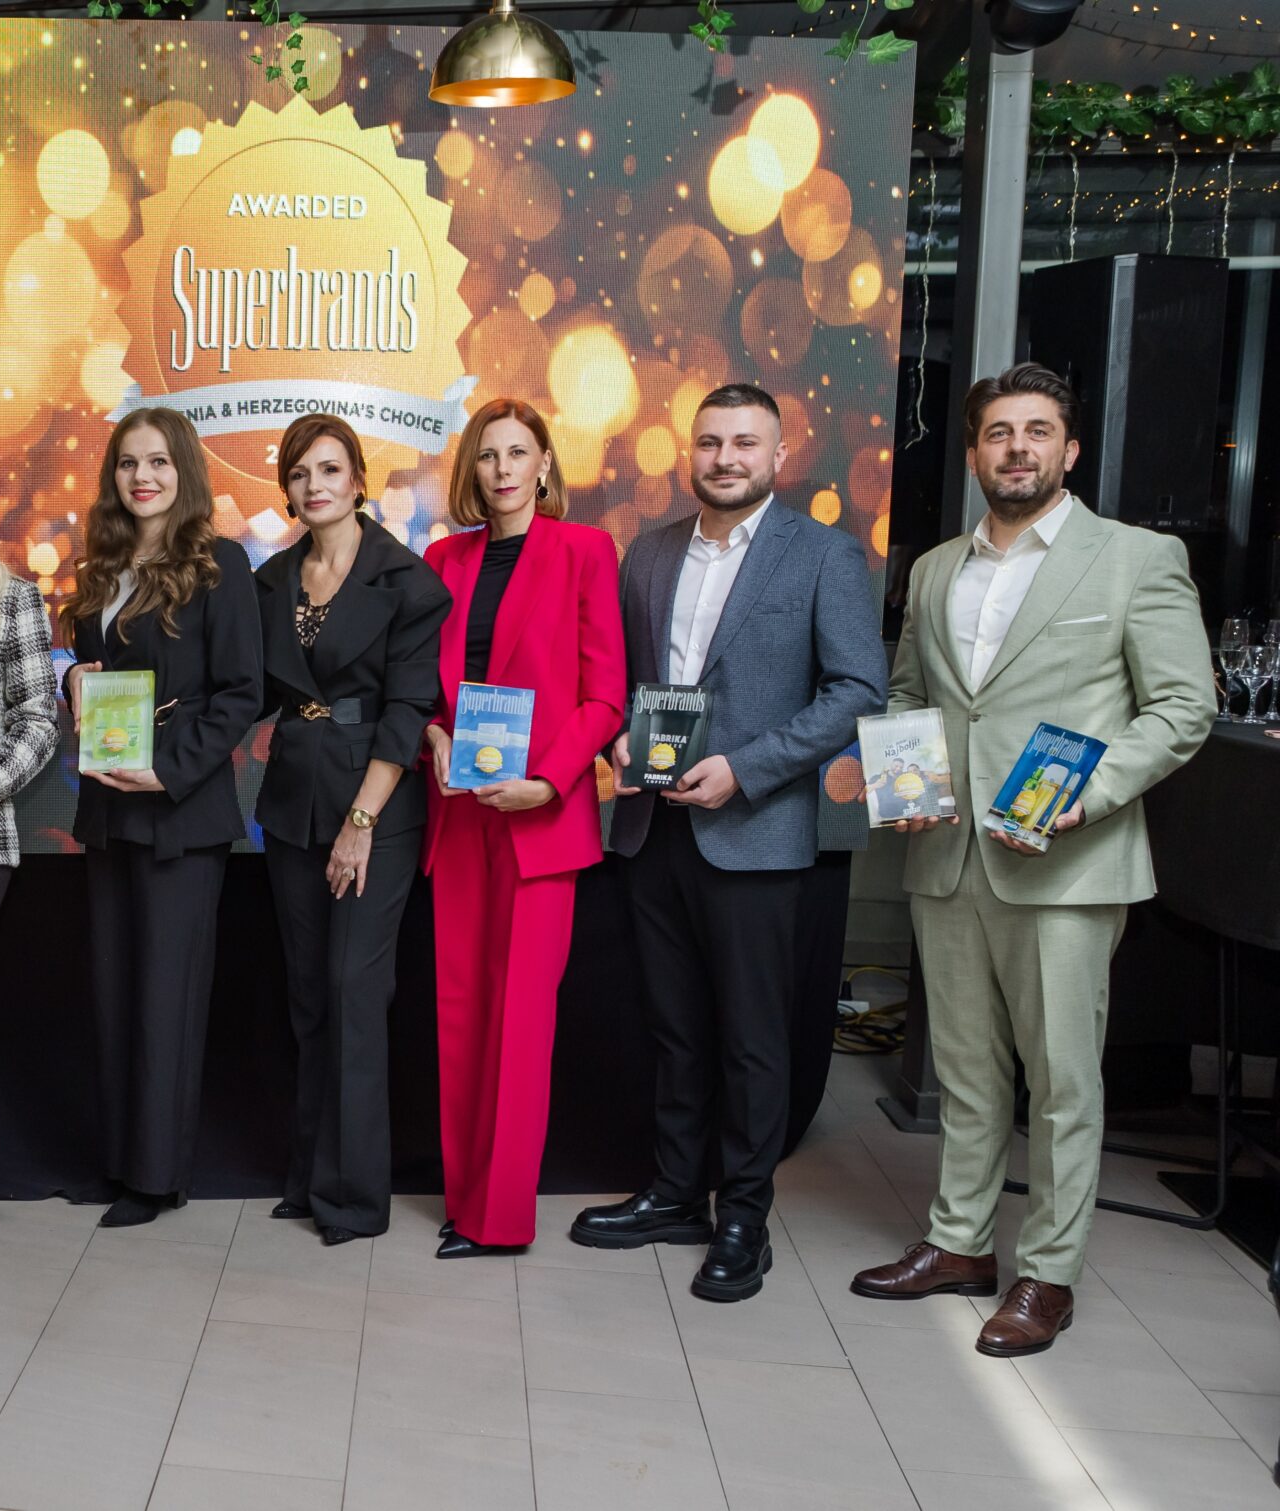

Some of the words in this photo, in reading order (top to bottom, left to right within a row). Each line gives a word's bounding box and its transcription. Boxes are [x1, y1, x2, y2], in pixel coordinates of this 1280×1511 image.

[227, 193, 368, 219] AWARDED
[171, 245, 418, 373] Superbrands
[184, 405, 217, 421] NIA
[222, 402, 232, 417] &
[237, 399, 375, 419] HERZEGOVINA'S
[380, 407, 444, 435] CHOICE
[461, 686, 531, 716] Superbrands
[636, 686, 706, 714] Superbrands
[649, 733, 687, 744] FABRIKA
[1026, 725, 1087, 764] Superbrands
[644, 773, 672, 781] FABRIKA
